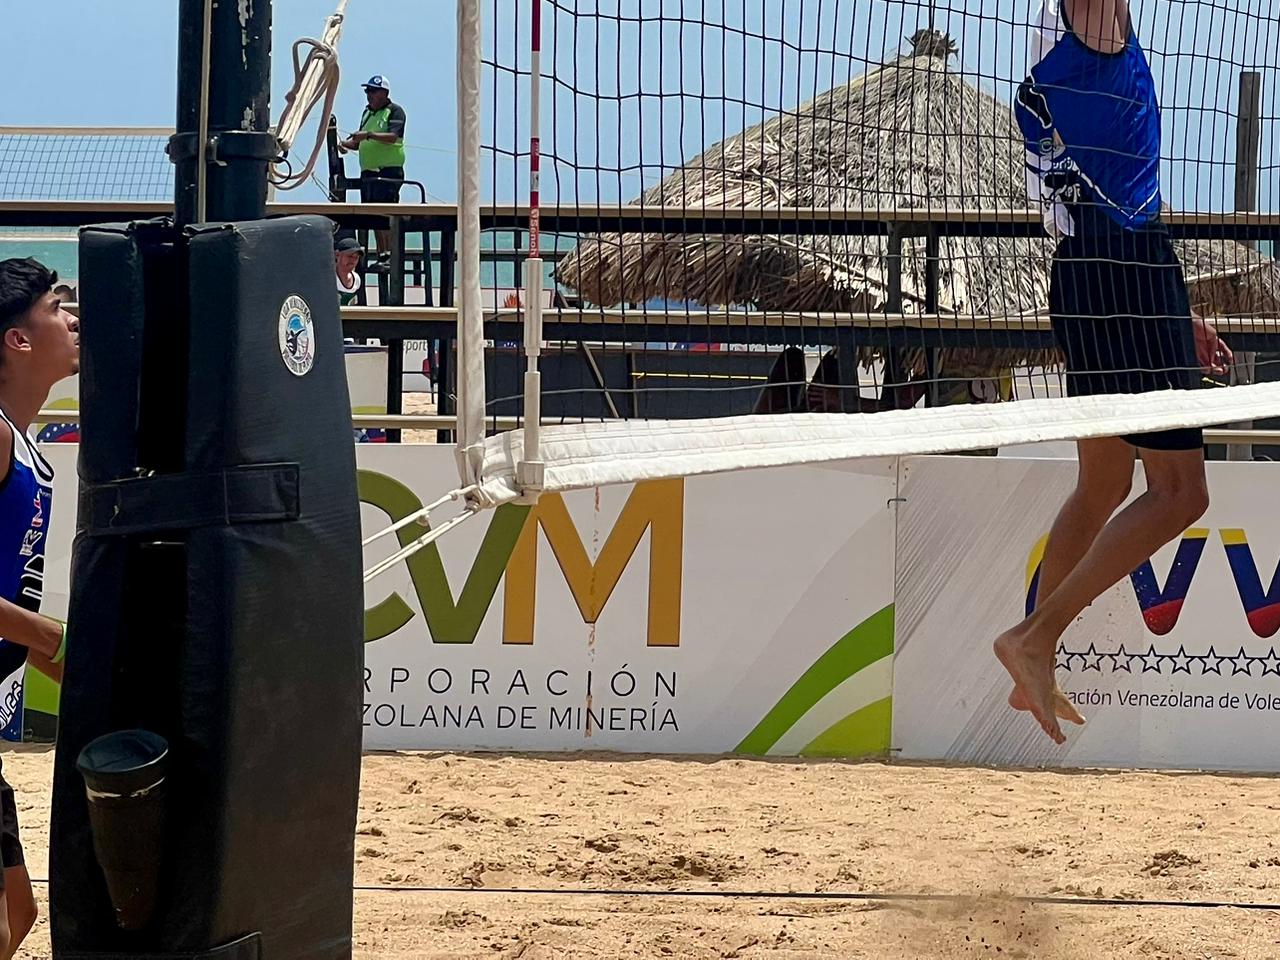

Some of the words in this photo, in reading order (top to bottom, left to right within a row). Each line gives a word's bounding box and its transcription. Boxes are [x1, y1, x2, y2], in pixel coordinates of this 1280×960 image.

[1064, 688, 1112, 705] ación
[1118, 690, 1214, 709] Venezolana
[1219, 691, 1240, 709] de
[497, 706, 537, 729] DE
[550, 701, 679, 732] MINERÍA
